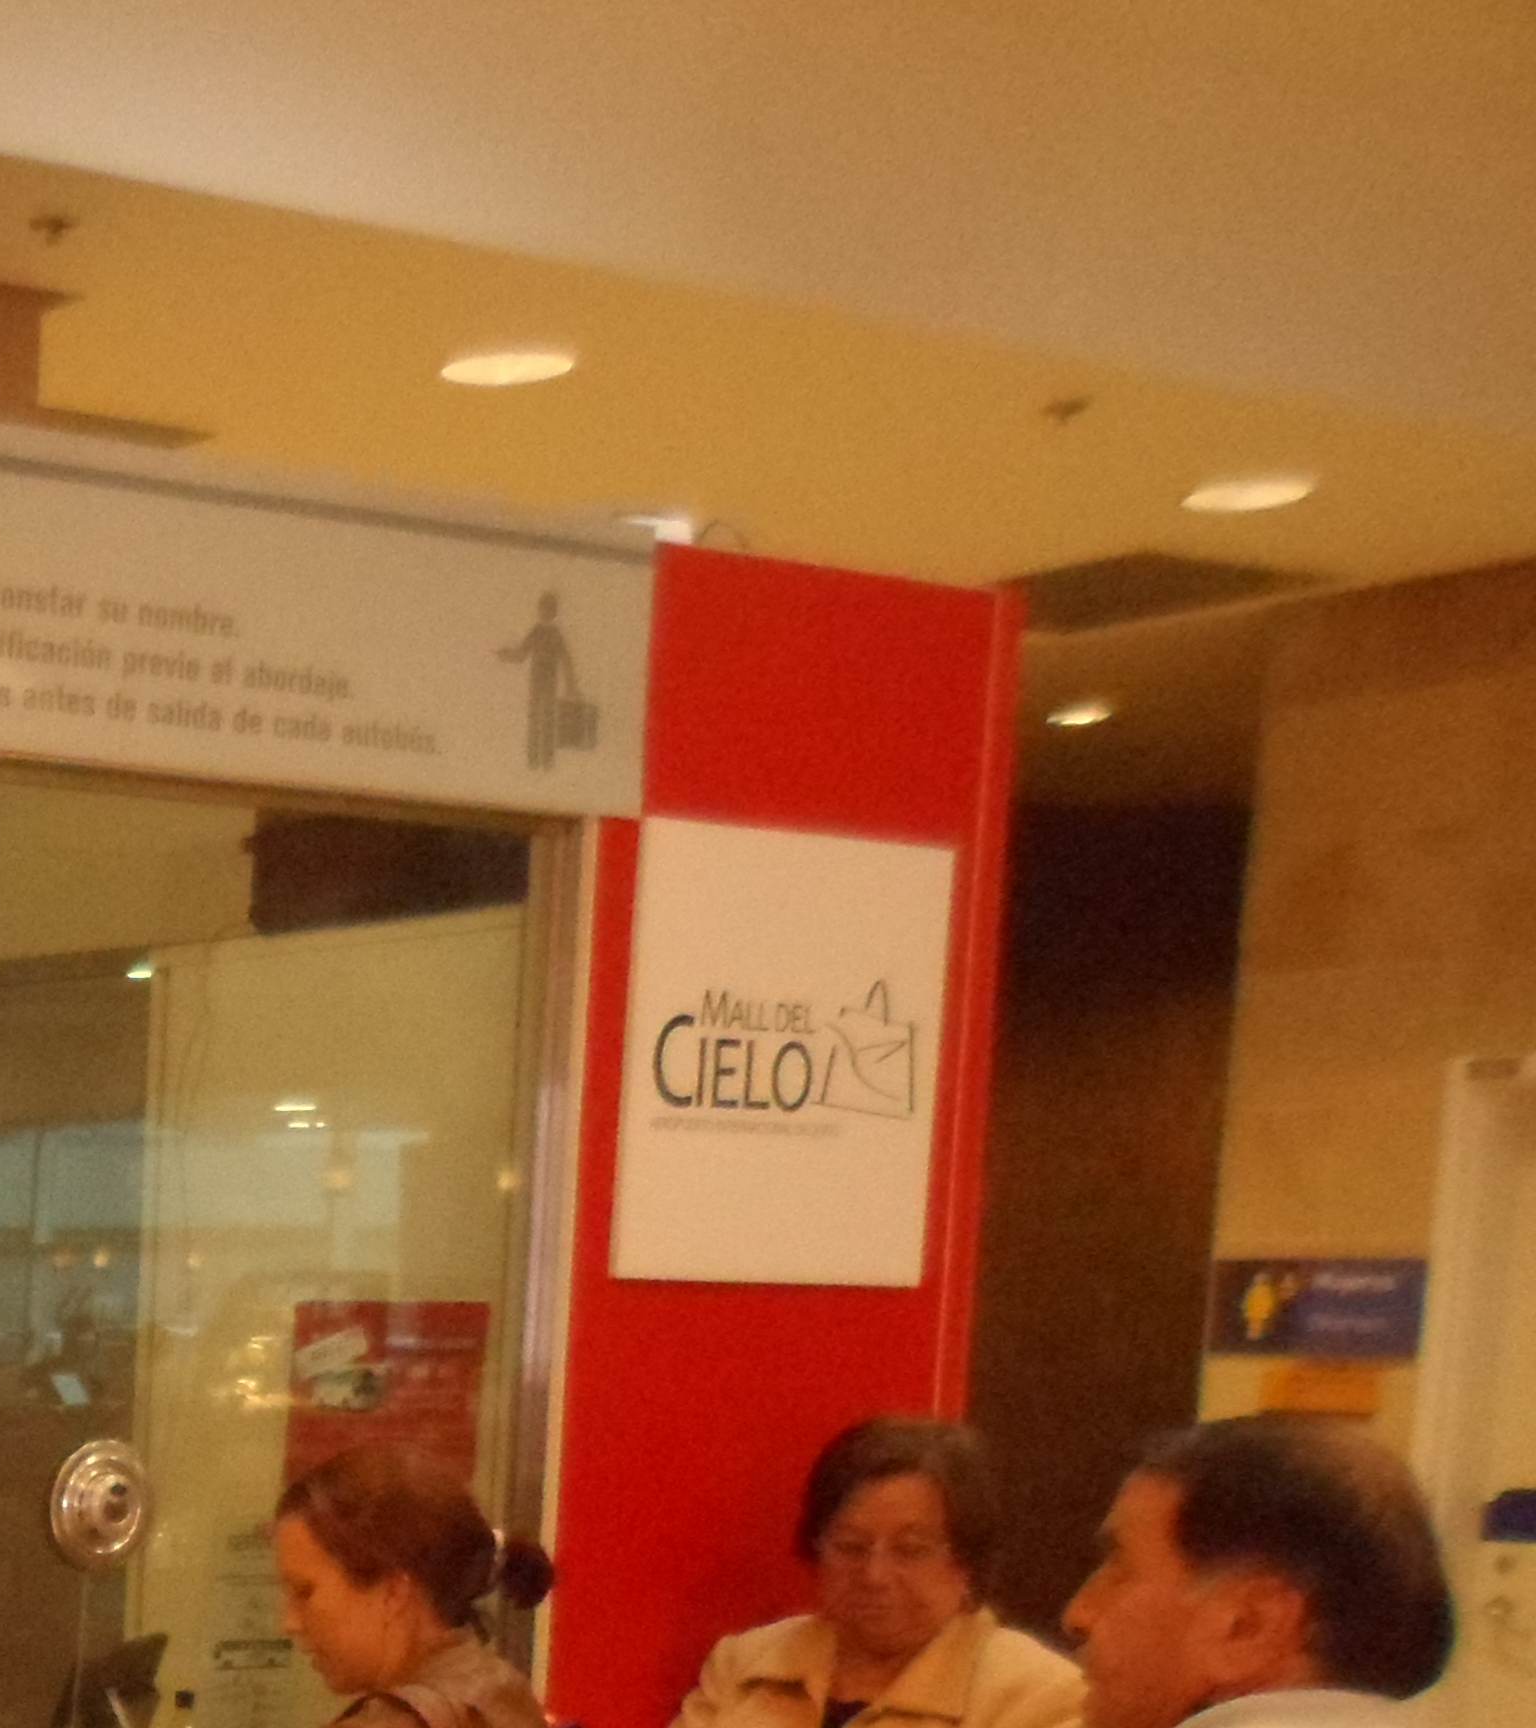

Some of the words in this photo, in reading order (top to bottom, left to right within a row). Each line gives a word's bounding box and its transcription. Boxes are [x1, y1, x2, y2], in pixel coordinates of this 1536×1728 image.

[96, 598, 128, 624] su
[137, 603, 239, 639] nombre.
[22, 685, 96, 718] antes
[106, 692, 136, 722] de
[145, 700, 223, 733] salida
[232, 707, 264, 735] de
[274, 714, 331, 742] cada
